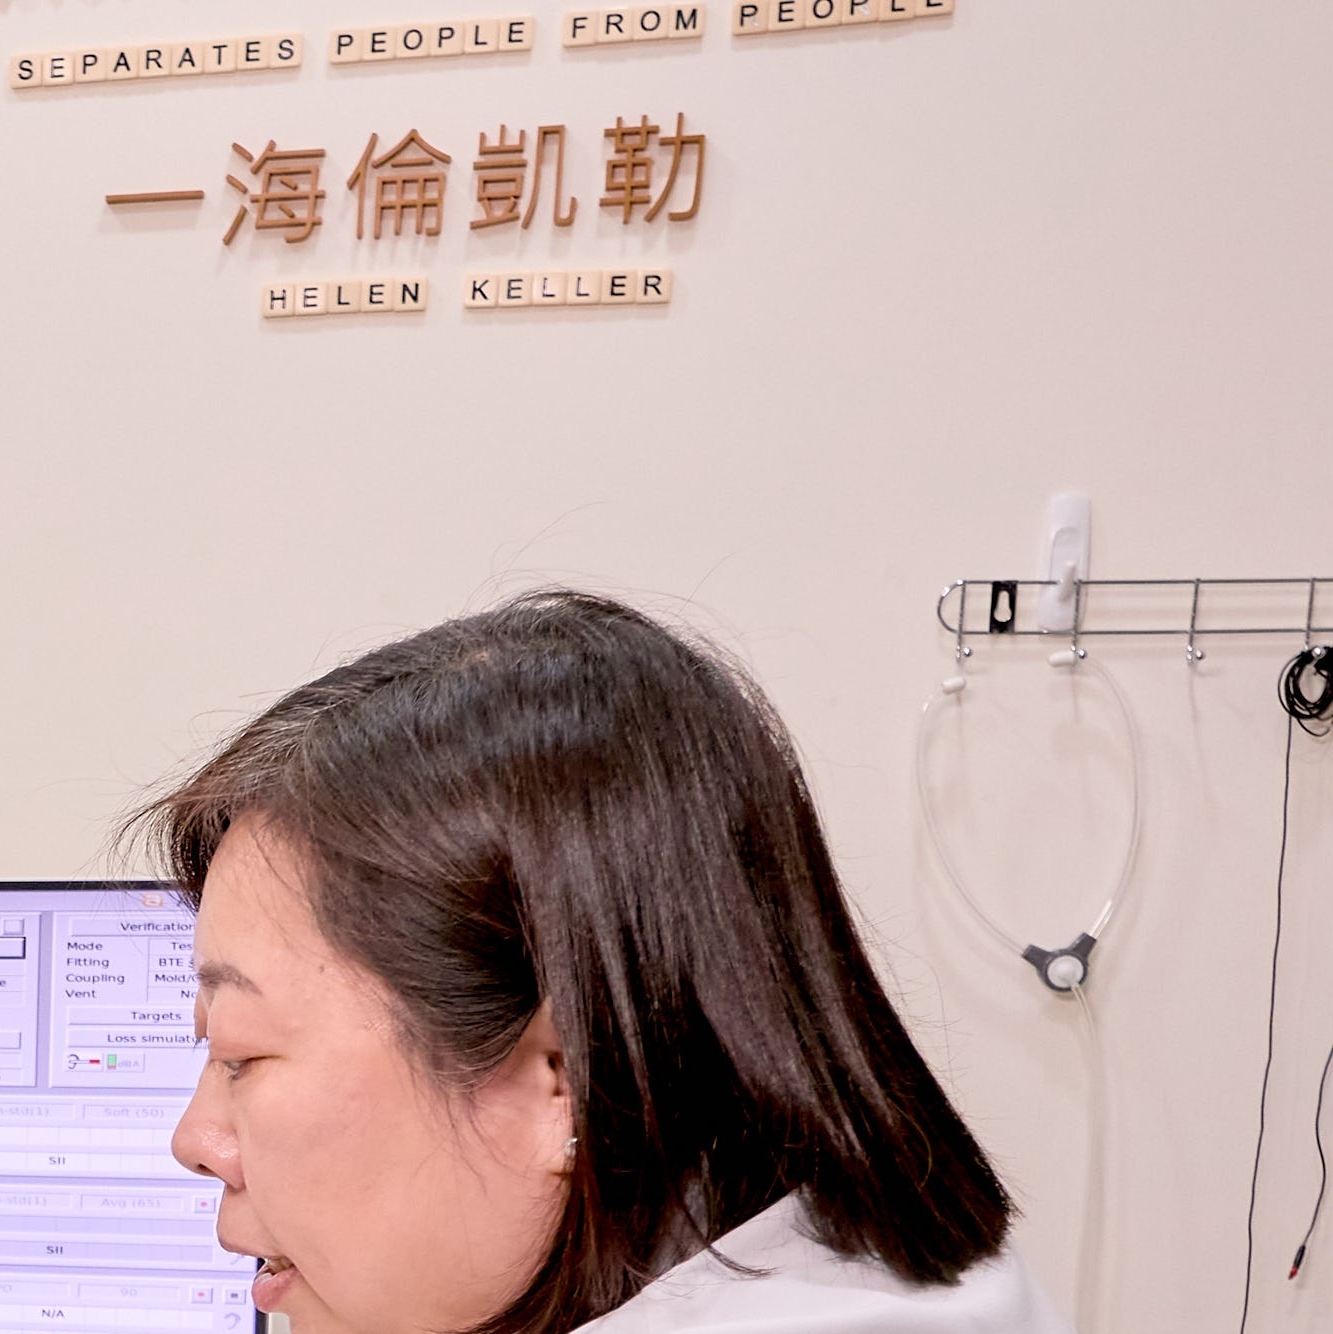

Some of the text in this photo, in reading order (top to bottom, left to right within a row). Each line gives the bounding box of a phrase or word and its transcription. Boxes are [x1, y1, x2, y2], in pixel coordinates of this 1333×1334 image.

[18, 37, 296, 81] SEPARATES
[336, 20, 526, 58] PEOPLE
[571, 6, 700, 40] FROM
[268, 272, 664, 312] HELEN KELLER
[66, 942, 103, 950] Mode
[66, 958, 110, 969] Fitting
[159, 958, 183, 967] BTE
[65, 974, 125, 985] Coupling
[65, 990, 96, 998] Vent
[131, 1012, 182, 1023] Targets
[107, 1034, 137, 1043] Loss
[41, 1308, 65, 1319] N/A
